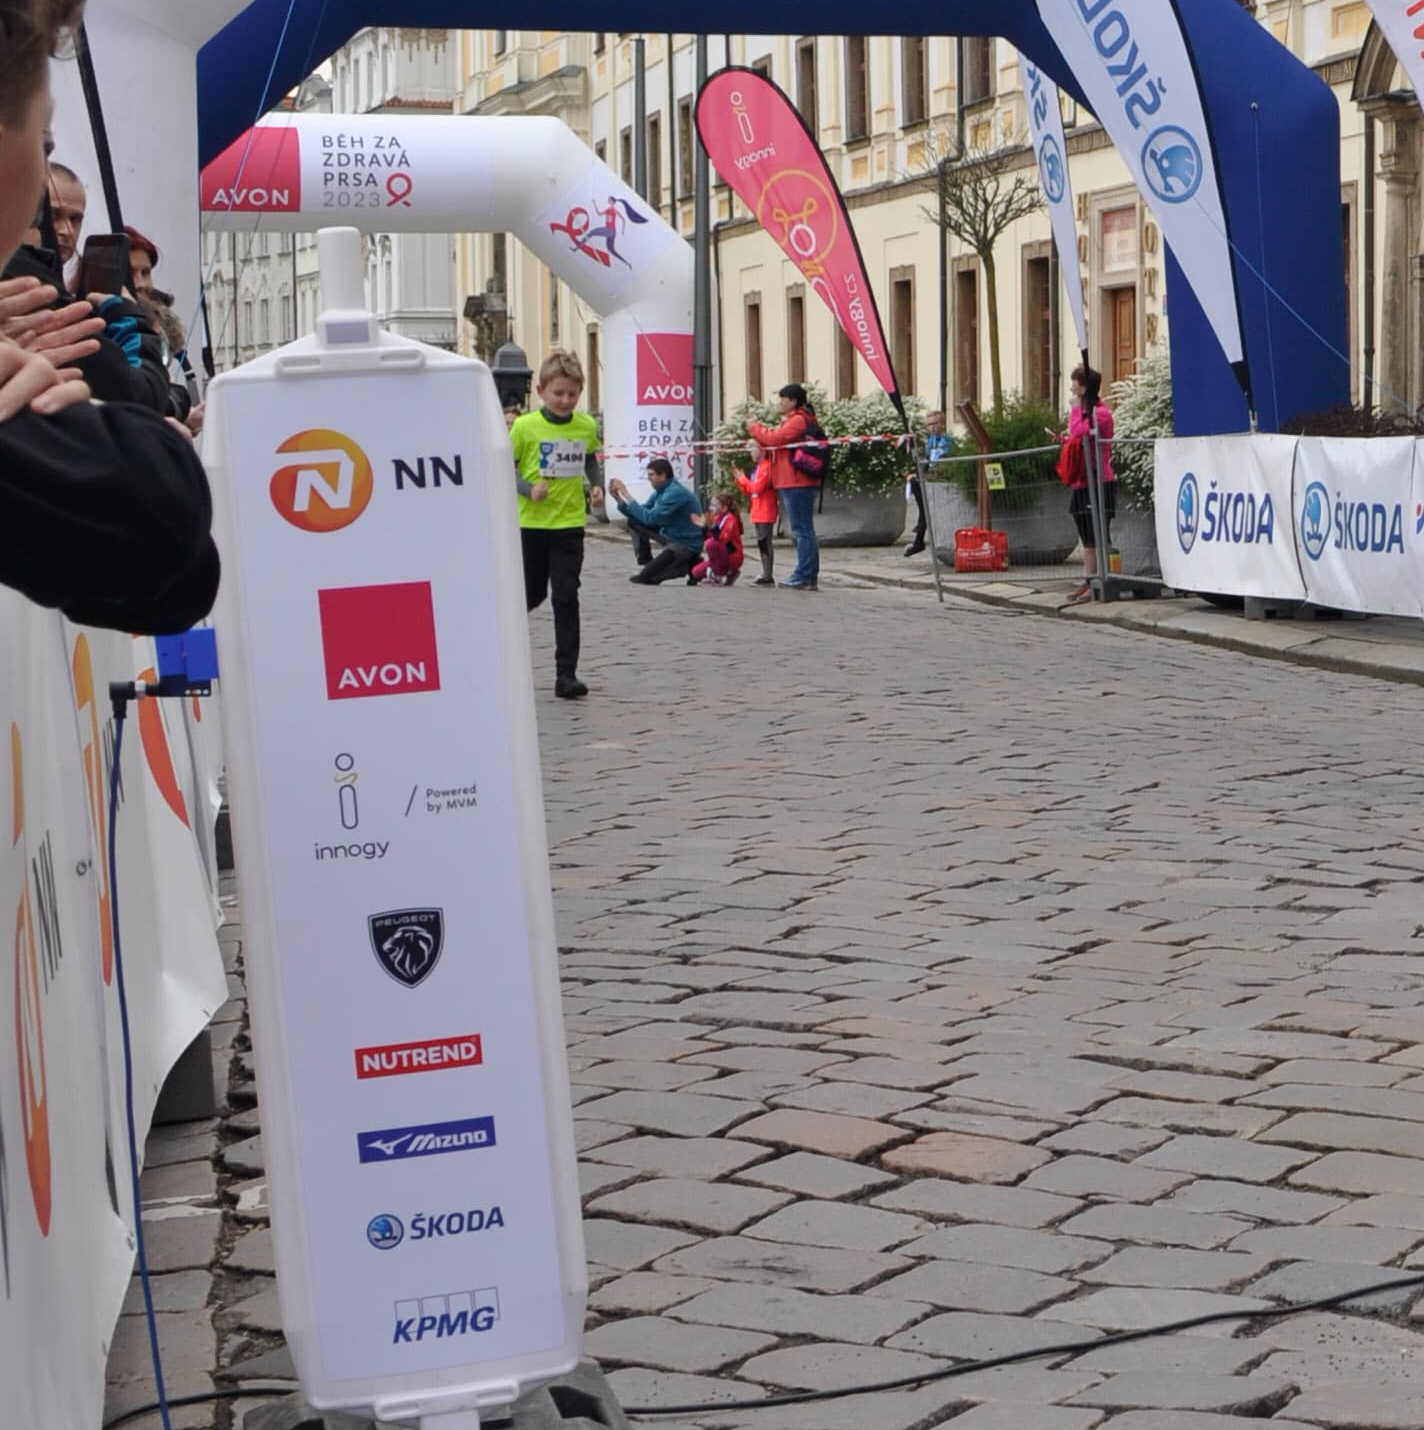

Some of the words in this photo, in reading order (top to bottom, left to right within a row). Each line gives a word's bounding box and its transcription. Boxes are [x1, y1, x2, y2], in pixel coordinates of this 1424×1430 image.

[375, 136, 401, 149] ZA
[323, 150, 411, 168] ZDRAVÁ
[323, 172, 378, 187] PRSA
[212, 188, 289, 206] AVON
[323, 191, 381, 208] 2023
[392, 455, 464, 490] NN
[1201, 481, 1274, 544] ŠKODA
[1334, 491, 1404, 554] ŠKODA
[338, 661, 426, 690] AVON
[426, 784, 477, 799] Powered
[427, 801, 443, 814] by
[446, 797, 478, 810] MVM
[314, 840, 390, 860] innogy
[375, 914, 436, 928] PEUGEOT
[362, 1041, 477, 1072] NUTREND
[410, 1206, 505, 1240] ŠKODA
[392, 1305, 496, 1345] KPMG
